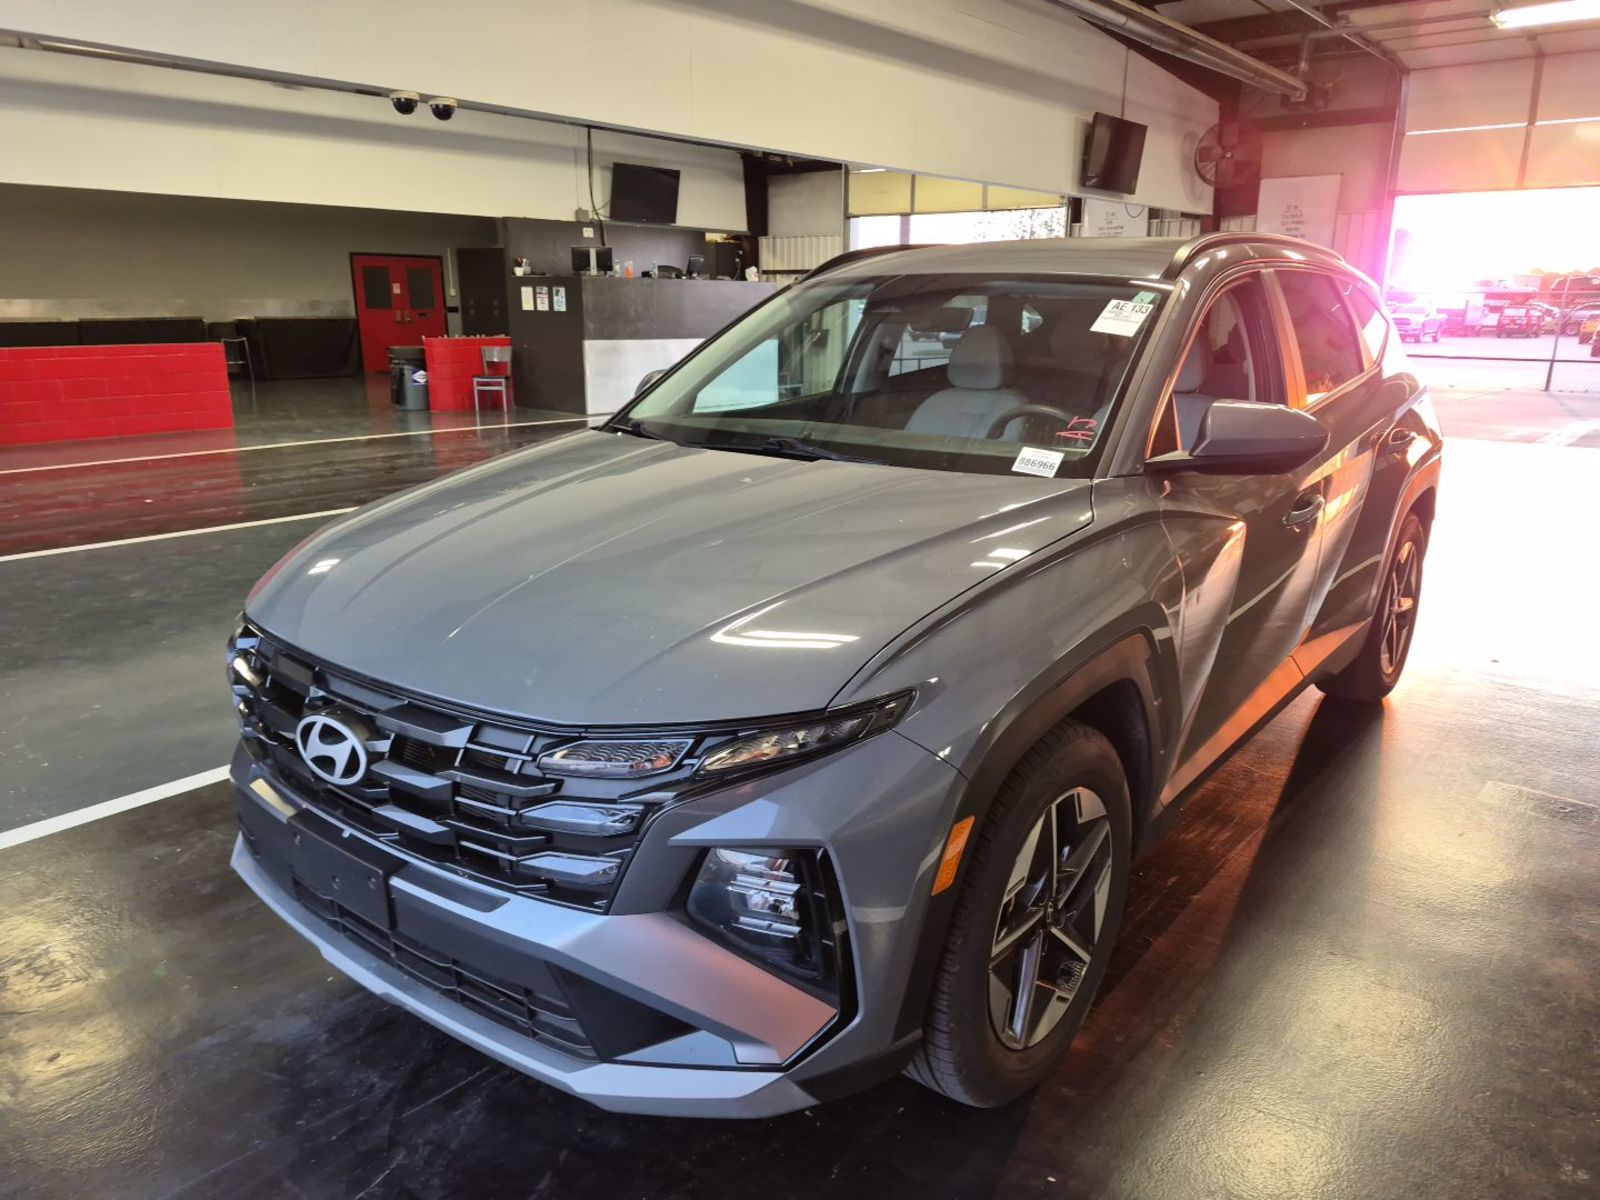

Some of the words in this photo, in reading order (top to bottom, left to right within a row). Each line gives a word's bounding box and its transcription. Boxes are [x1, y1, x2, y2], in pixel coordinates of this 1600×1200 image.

[1112, 302, 1129, 311] AE
[1131, 304, 1150, 314] 133
[1018, 457, 1056, 471] 886966
